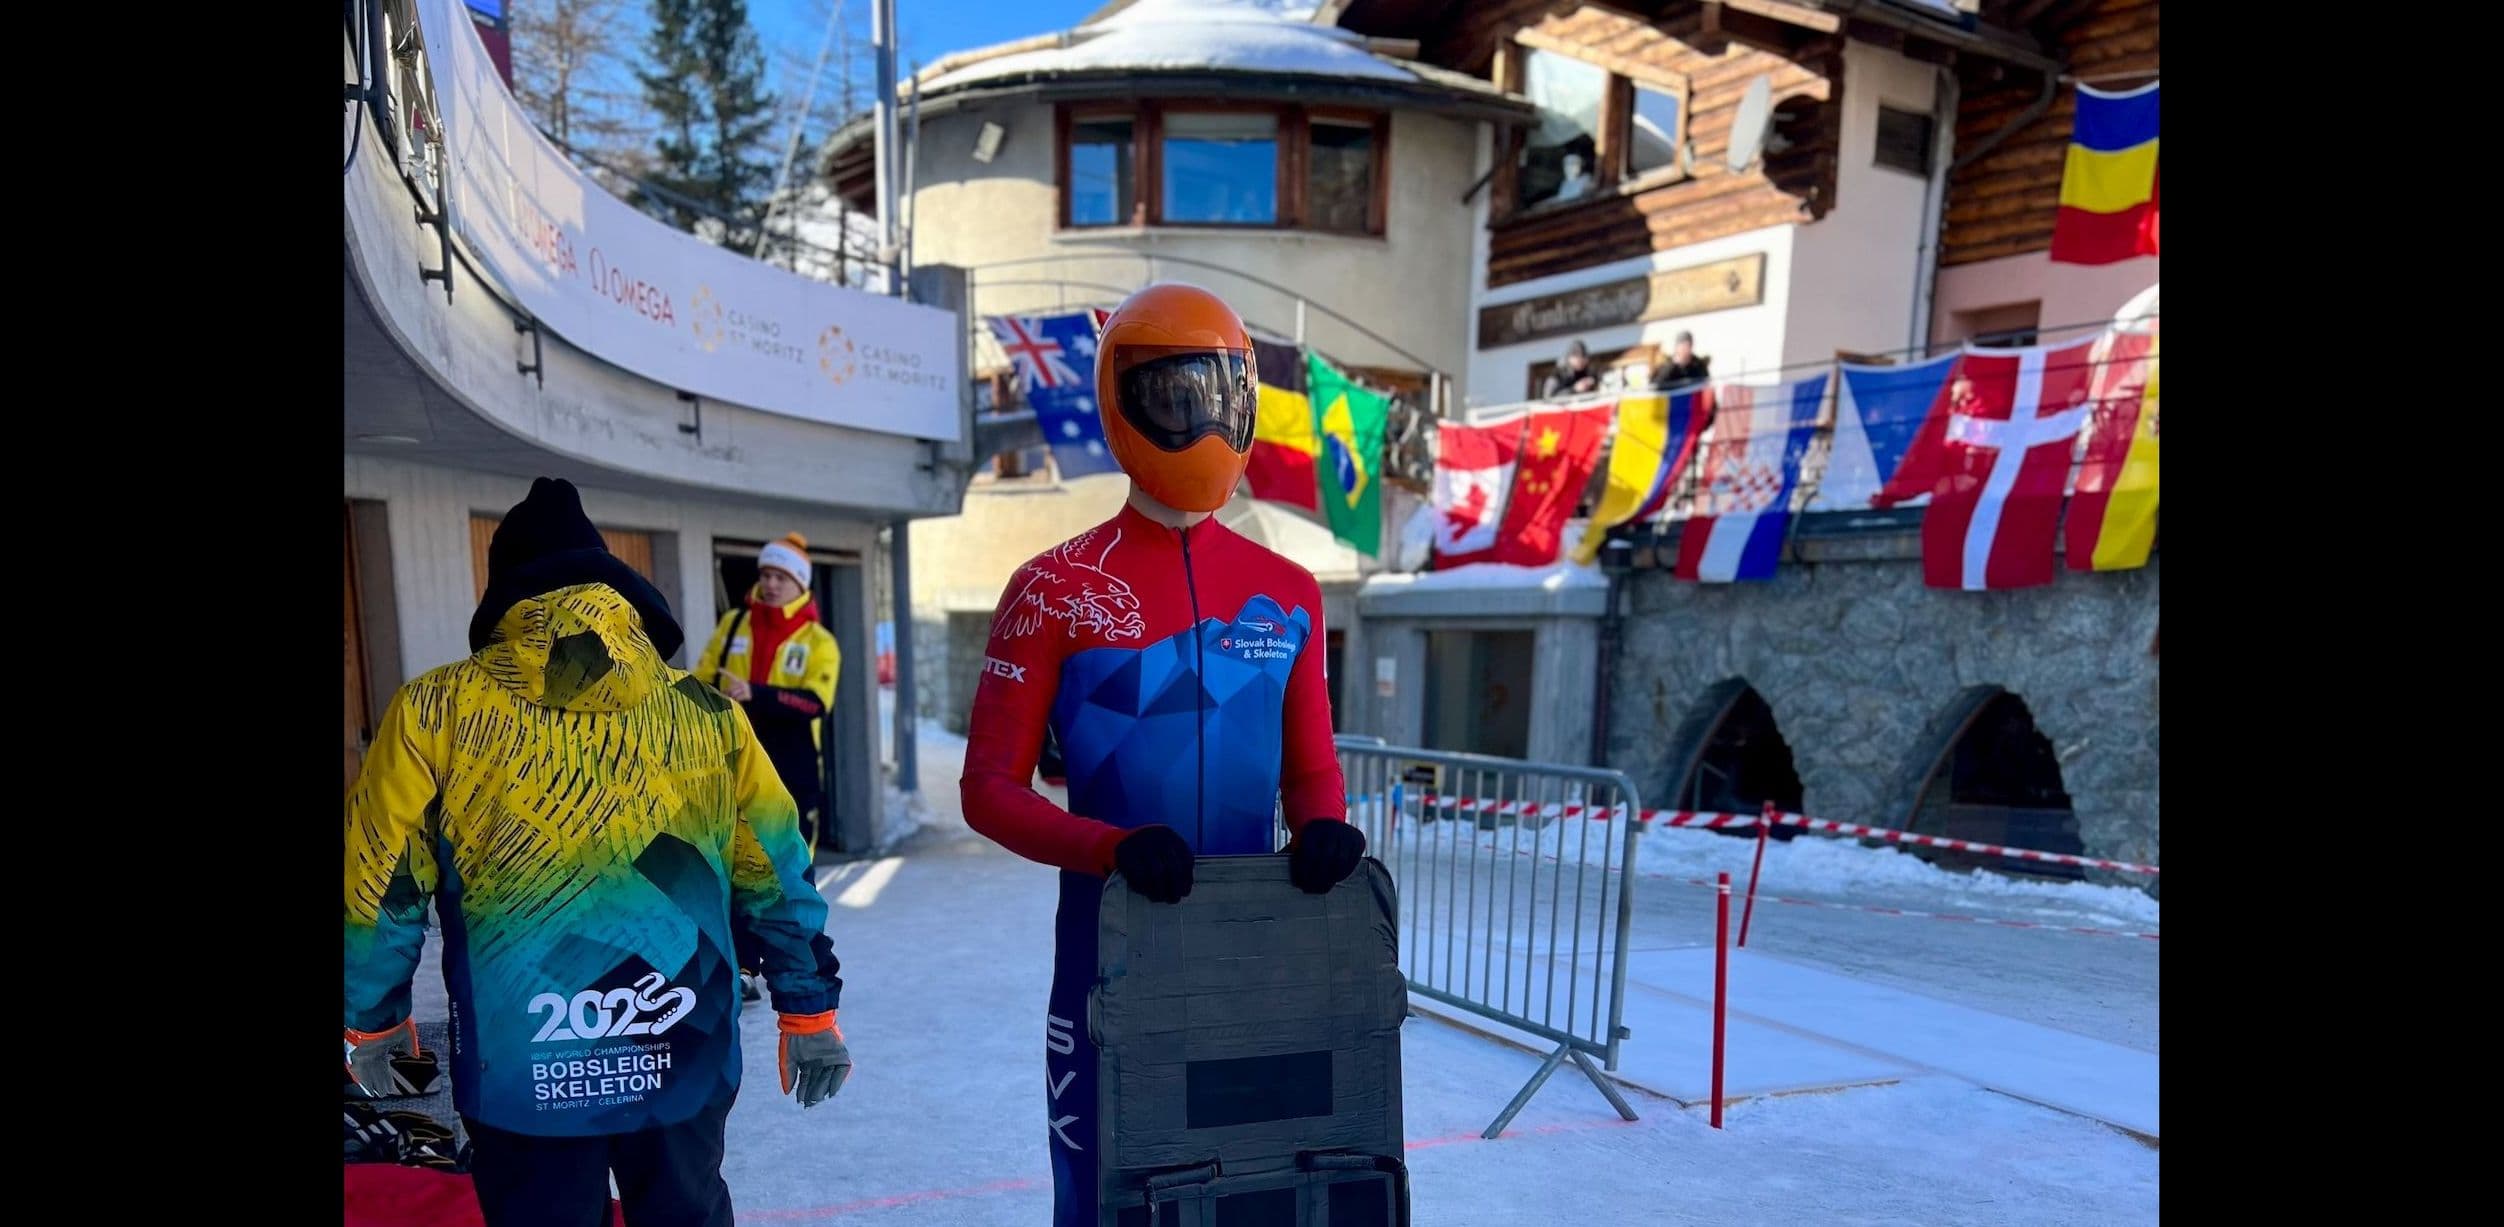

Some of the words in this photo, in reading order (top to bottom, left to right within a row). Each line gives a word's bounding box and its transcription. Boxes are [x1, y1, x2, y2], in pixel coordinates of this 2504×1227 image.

[610, 266, 675, 326] OMEGA
[727, 309, 781, 338] CASINO
[861, 344, 922, 369] CASINO
[887, 370, 946, 393] MORITZ
[1235, 638, 1265, 649] Slovak
[1243, 649, 1251, 659] &
[1253, 649, 1287, 659] Skeleton
[556, 1049, 592, 1059] WORLD
[594, 1042, 671, 1057] CHAMPIONSHIPS
[532, 1053, 671, 1080] BOBSLEIGH
[534, 1073, 662, 1100] SKELETON
[553, 1099, 590, 1110] MORITZ
[598, 1094, 645, 1106] CELERINA
